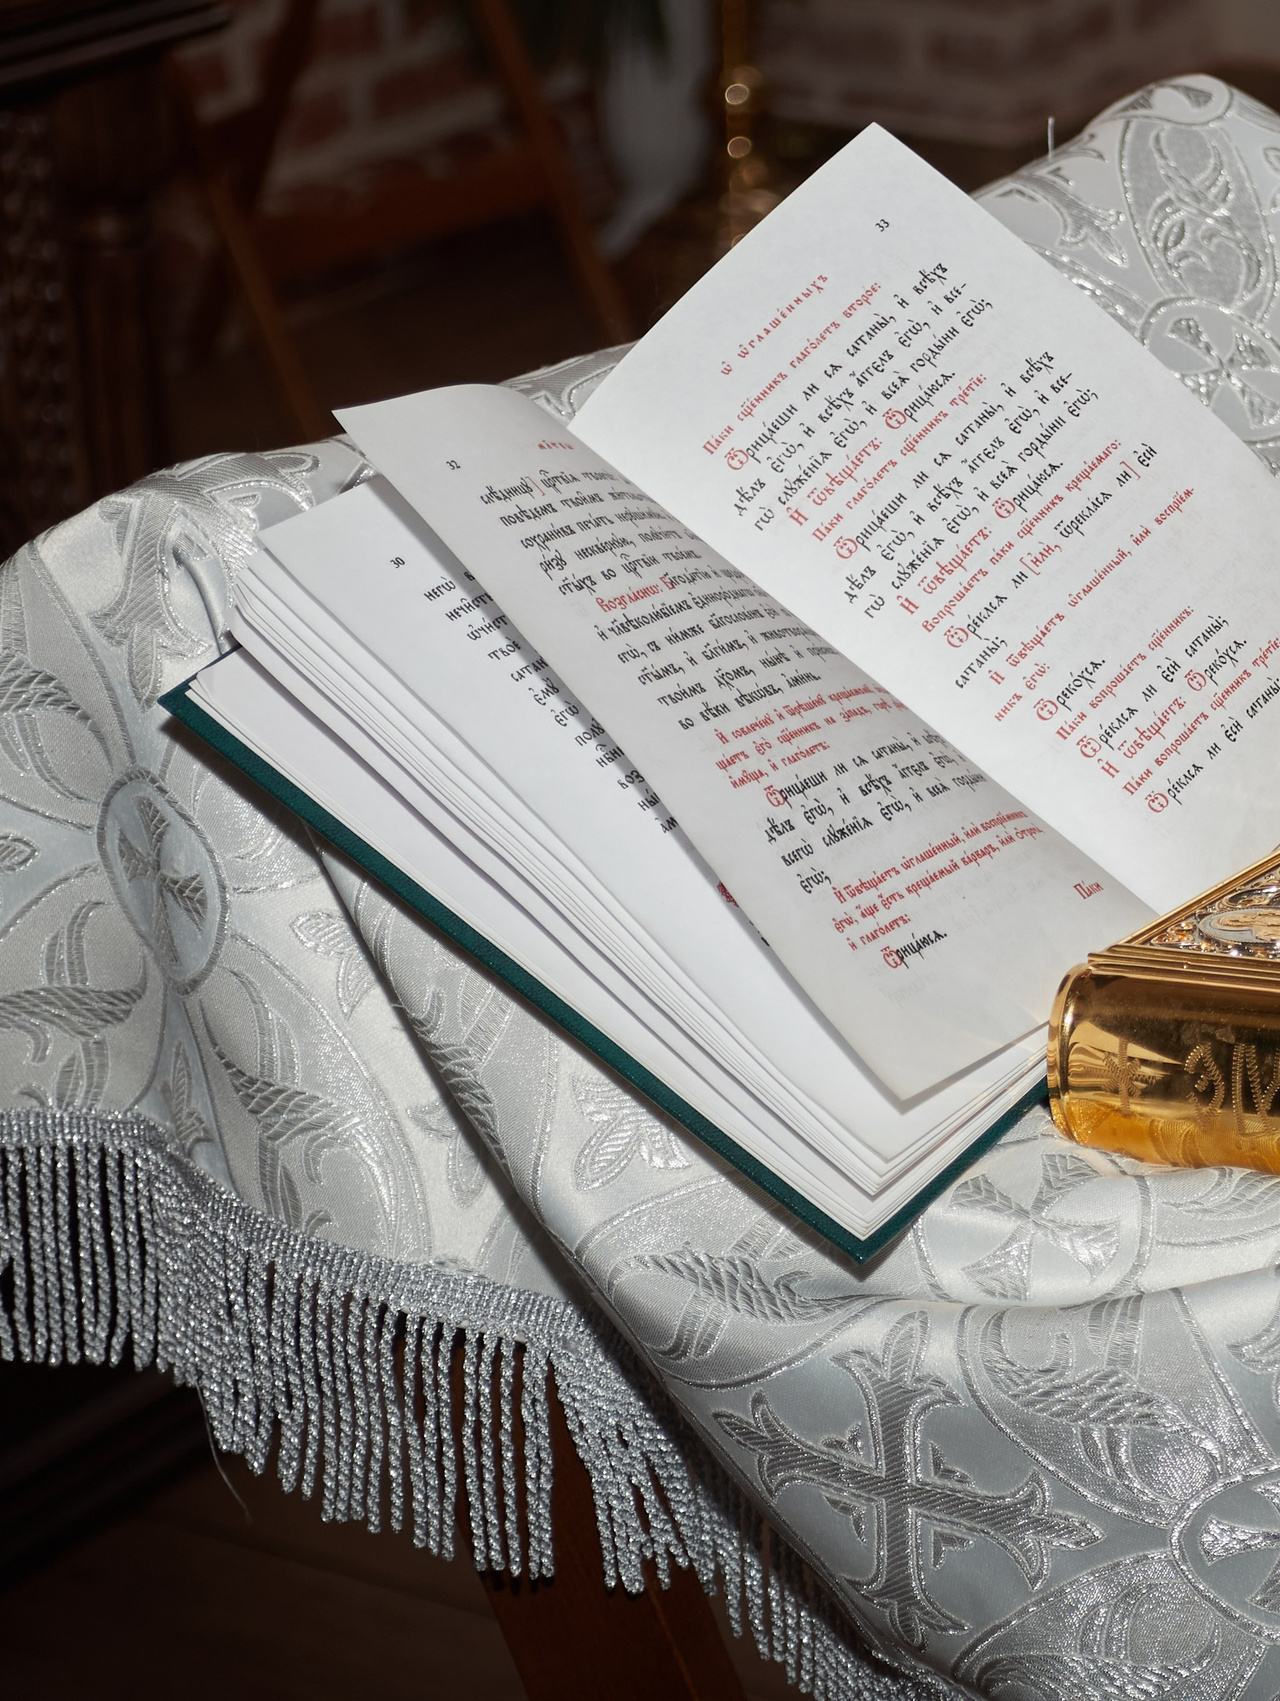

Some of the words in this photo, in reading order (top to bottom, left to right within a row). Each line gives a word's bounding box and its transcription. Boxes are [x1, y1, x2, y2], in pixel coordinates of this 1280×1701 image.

[875, 218, 891, 233] 33
[942, 282, 967, 305] все-
[802, 382, 820, 402] ли
[1049, 372, 1073, 394] все-
[446, 460, 461, 471] 32
[912, 470, 930, 490] ли
[1011, 570, 1029, 590] ли
[1115, 460, 1142, 488] ли]
[390, 556, 406, 570] 30
[510, 656, 549, 683] сатан
[1141, 683, 1158, 703] ли
[994, 692, 1023, 722] никъ
[1206, 742, 1222, 761] ли
